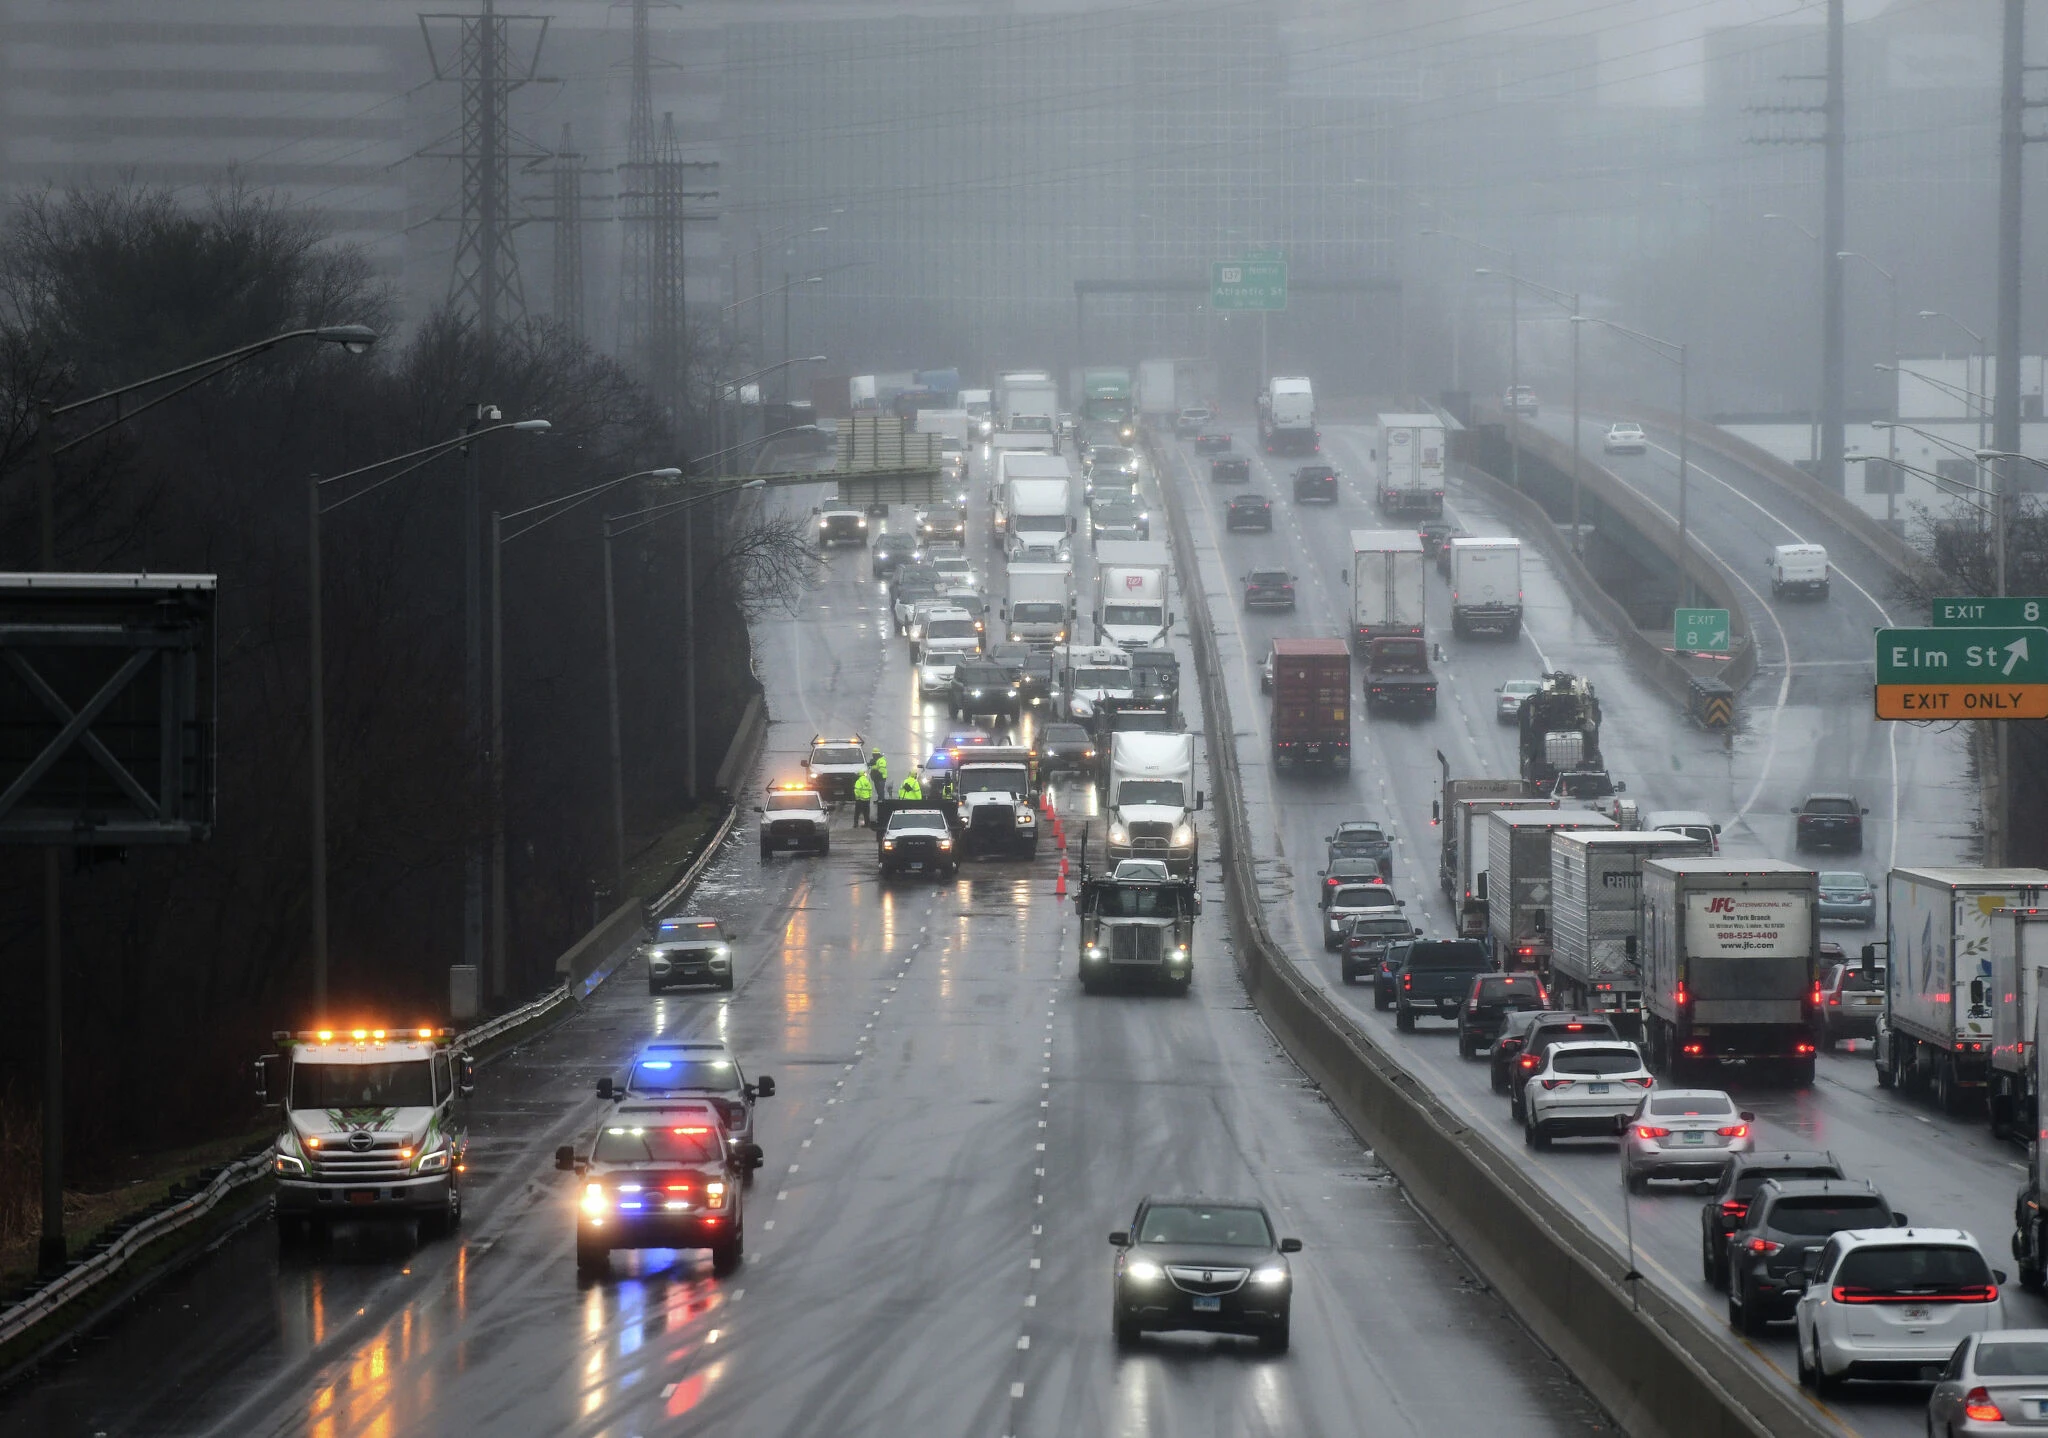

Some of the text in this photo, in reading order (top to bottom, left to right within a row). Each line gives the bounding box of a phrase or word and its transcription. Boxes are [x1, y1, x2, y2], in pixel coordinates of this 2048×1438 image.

[1216, 287, 1283, 296] Atlantic St
[1944, 601, 2040, 622] EXIT 8
[1688, 615, 1716, 625] EXIT
[1686, 631, 1698, 646] 8
[1892, 645, 1998, 667] Elm St
[1903, 693, 2023, 709] EXIT ONLY
[1704, 897, 1737, 913] JFC
[1717, 932, 1778, 940] 908-525-4400
[1721, 941, 1774, 950] www.jfc.com
